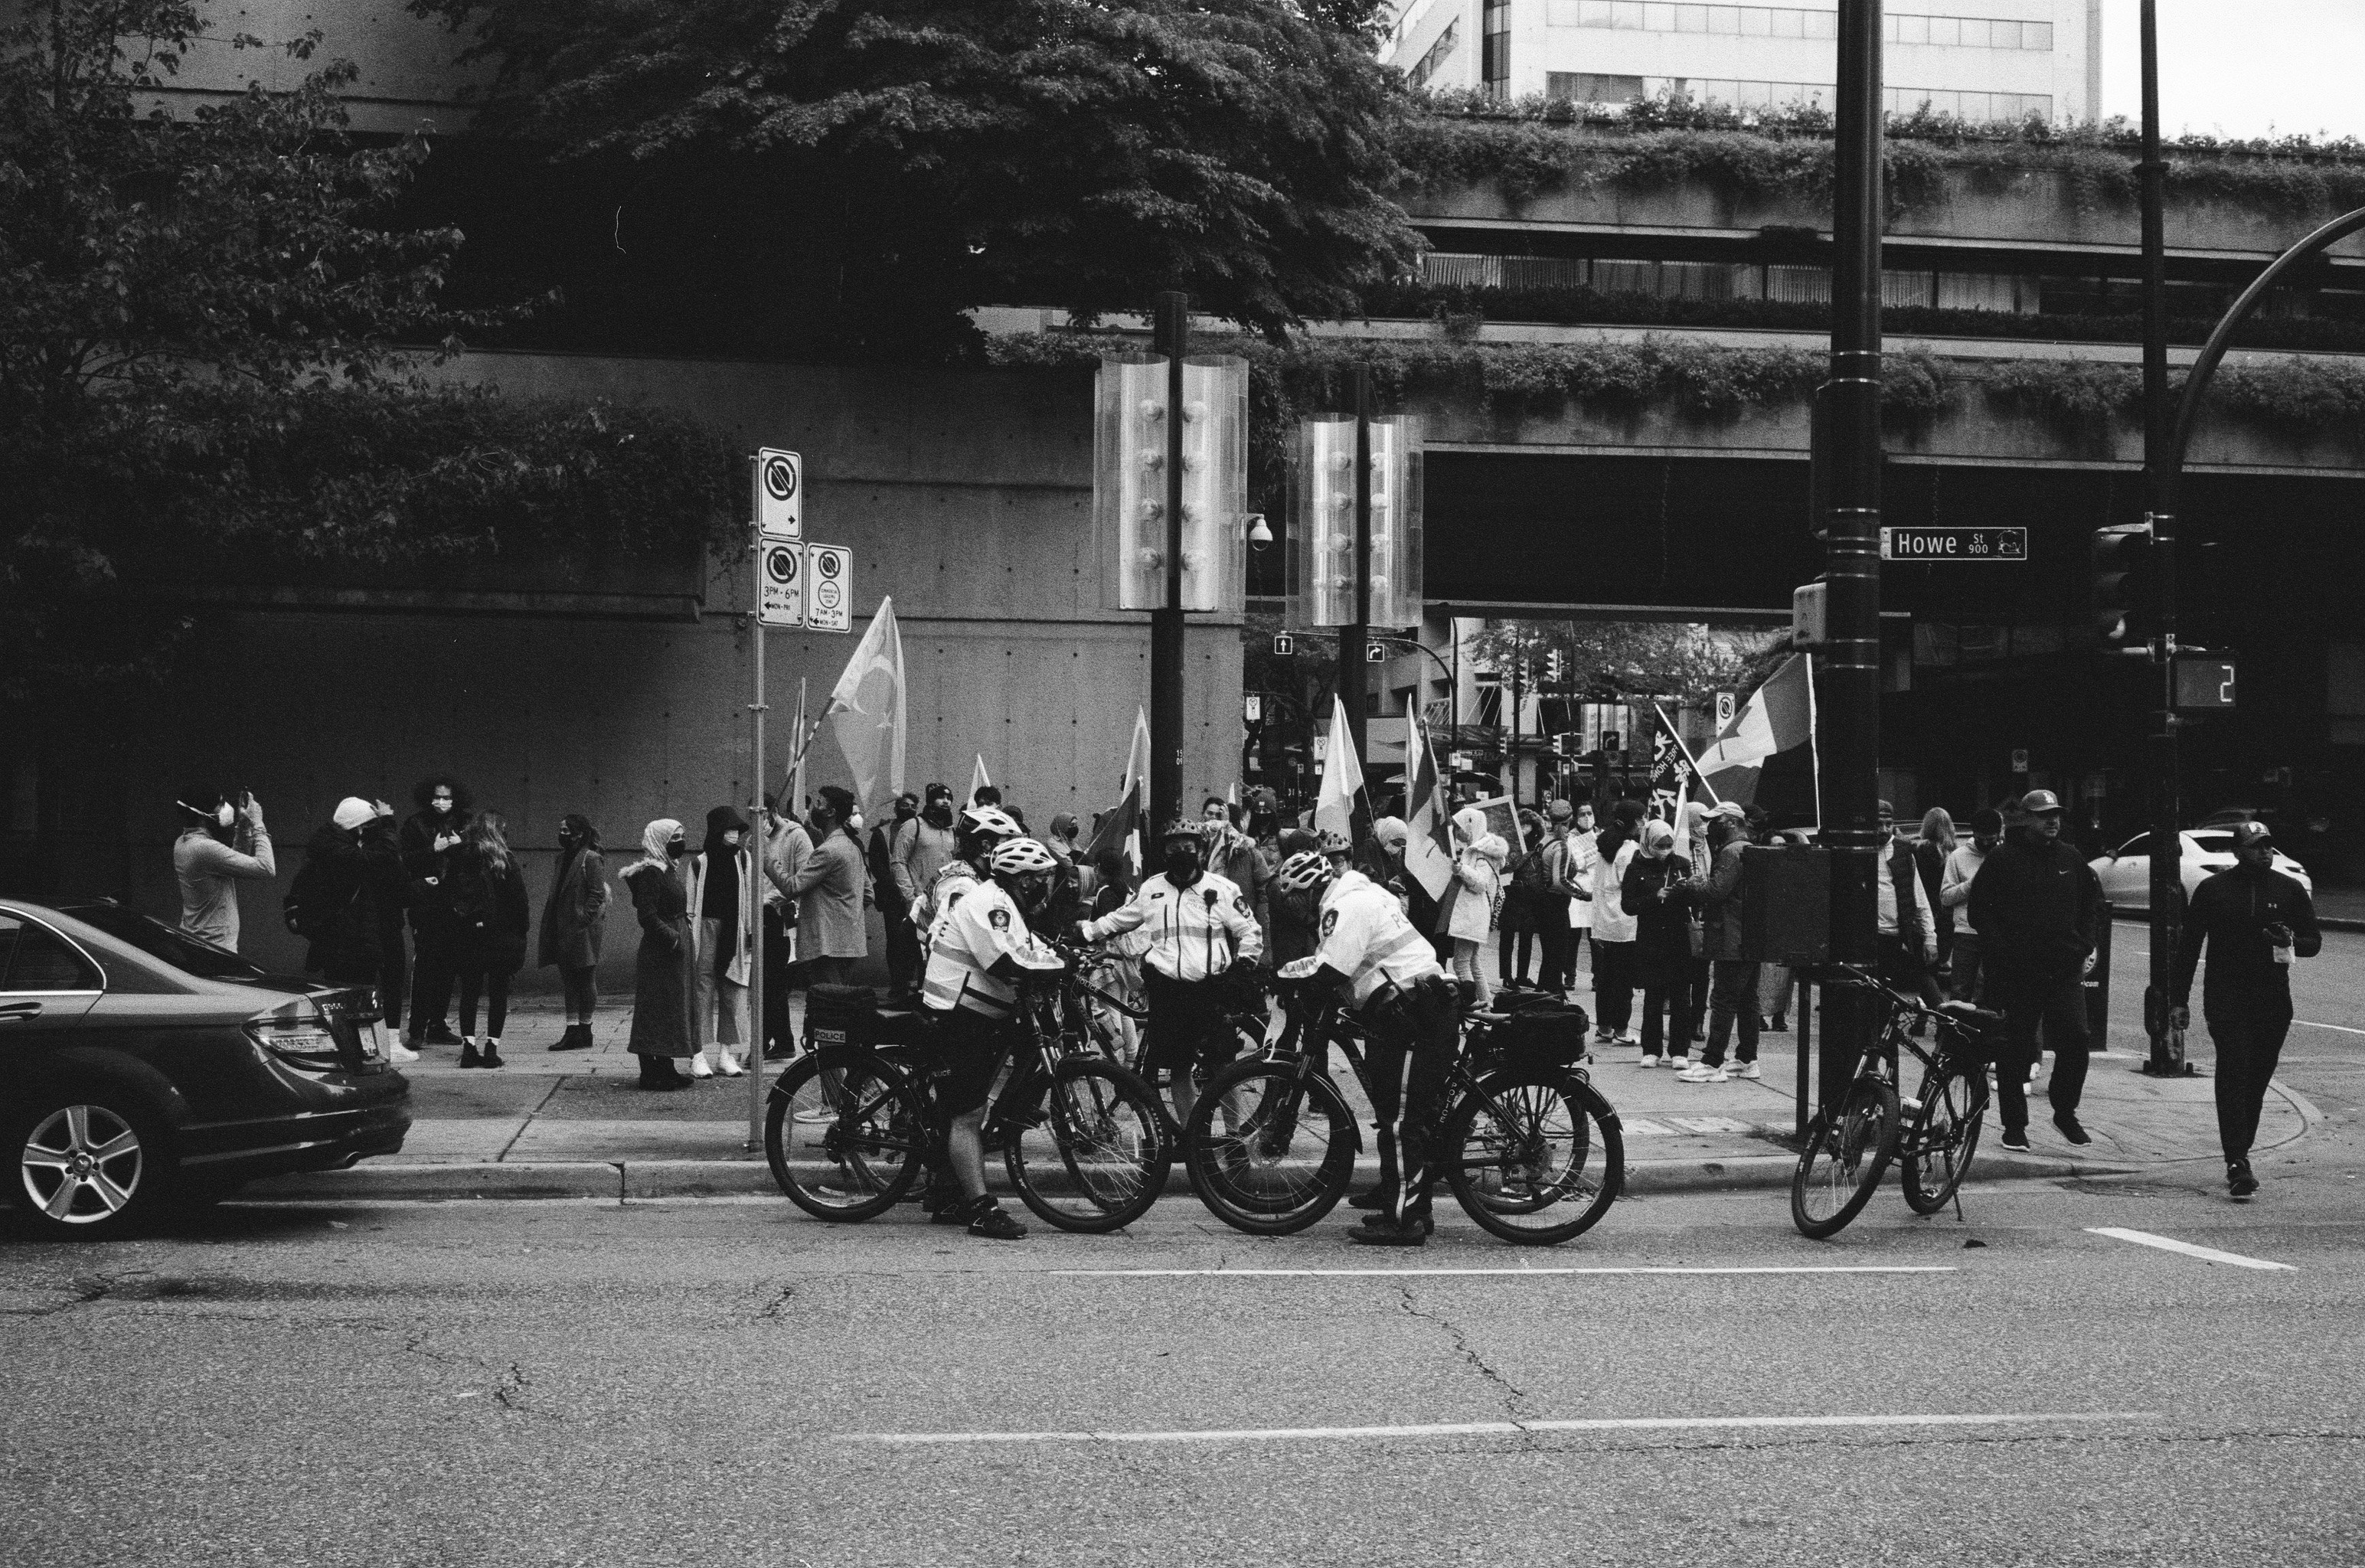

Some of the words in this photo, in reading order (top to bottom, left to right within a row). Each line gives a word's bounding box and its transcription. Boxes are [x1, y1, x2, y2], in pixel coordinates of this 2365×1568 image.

[1899, 534, 1957, 554] Howe
[1973, 534, 1984, 544] St
[1968, 544, 1988, 554] 900
[764, 586, 779, 597] 3PM
[785, 589, 800, 599] 6PM
[2220, 665, 2235, 703] 2
[815, 1030, 845, 1040] POLICE
[1439, 1082, 1458, 1123] POLICE
